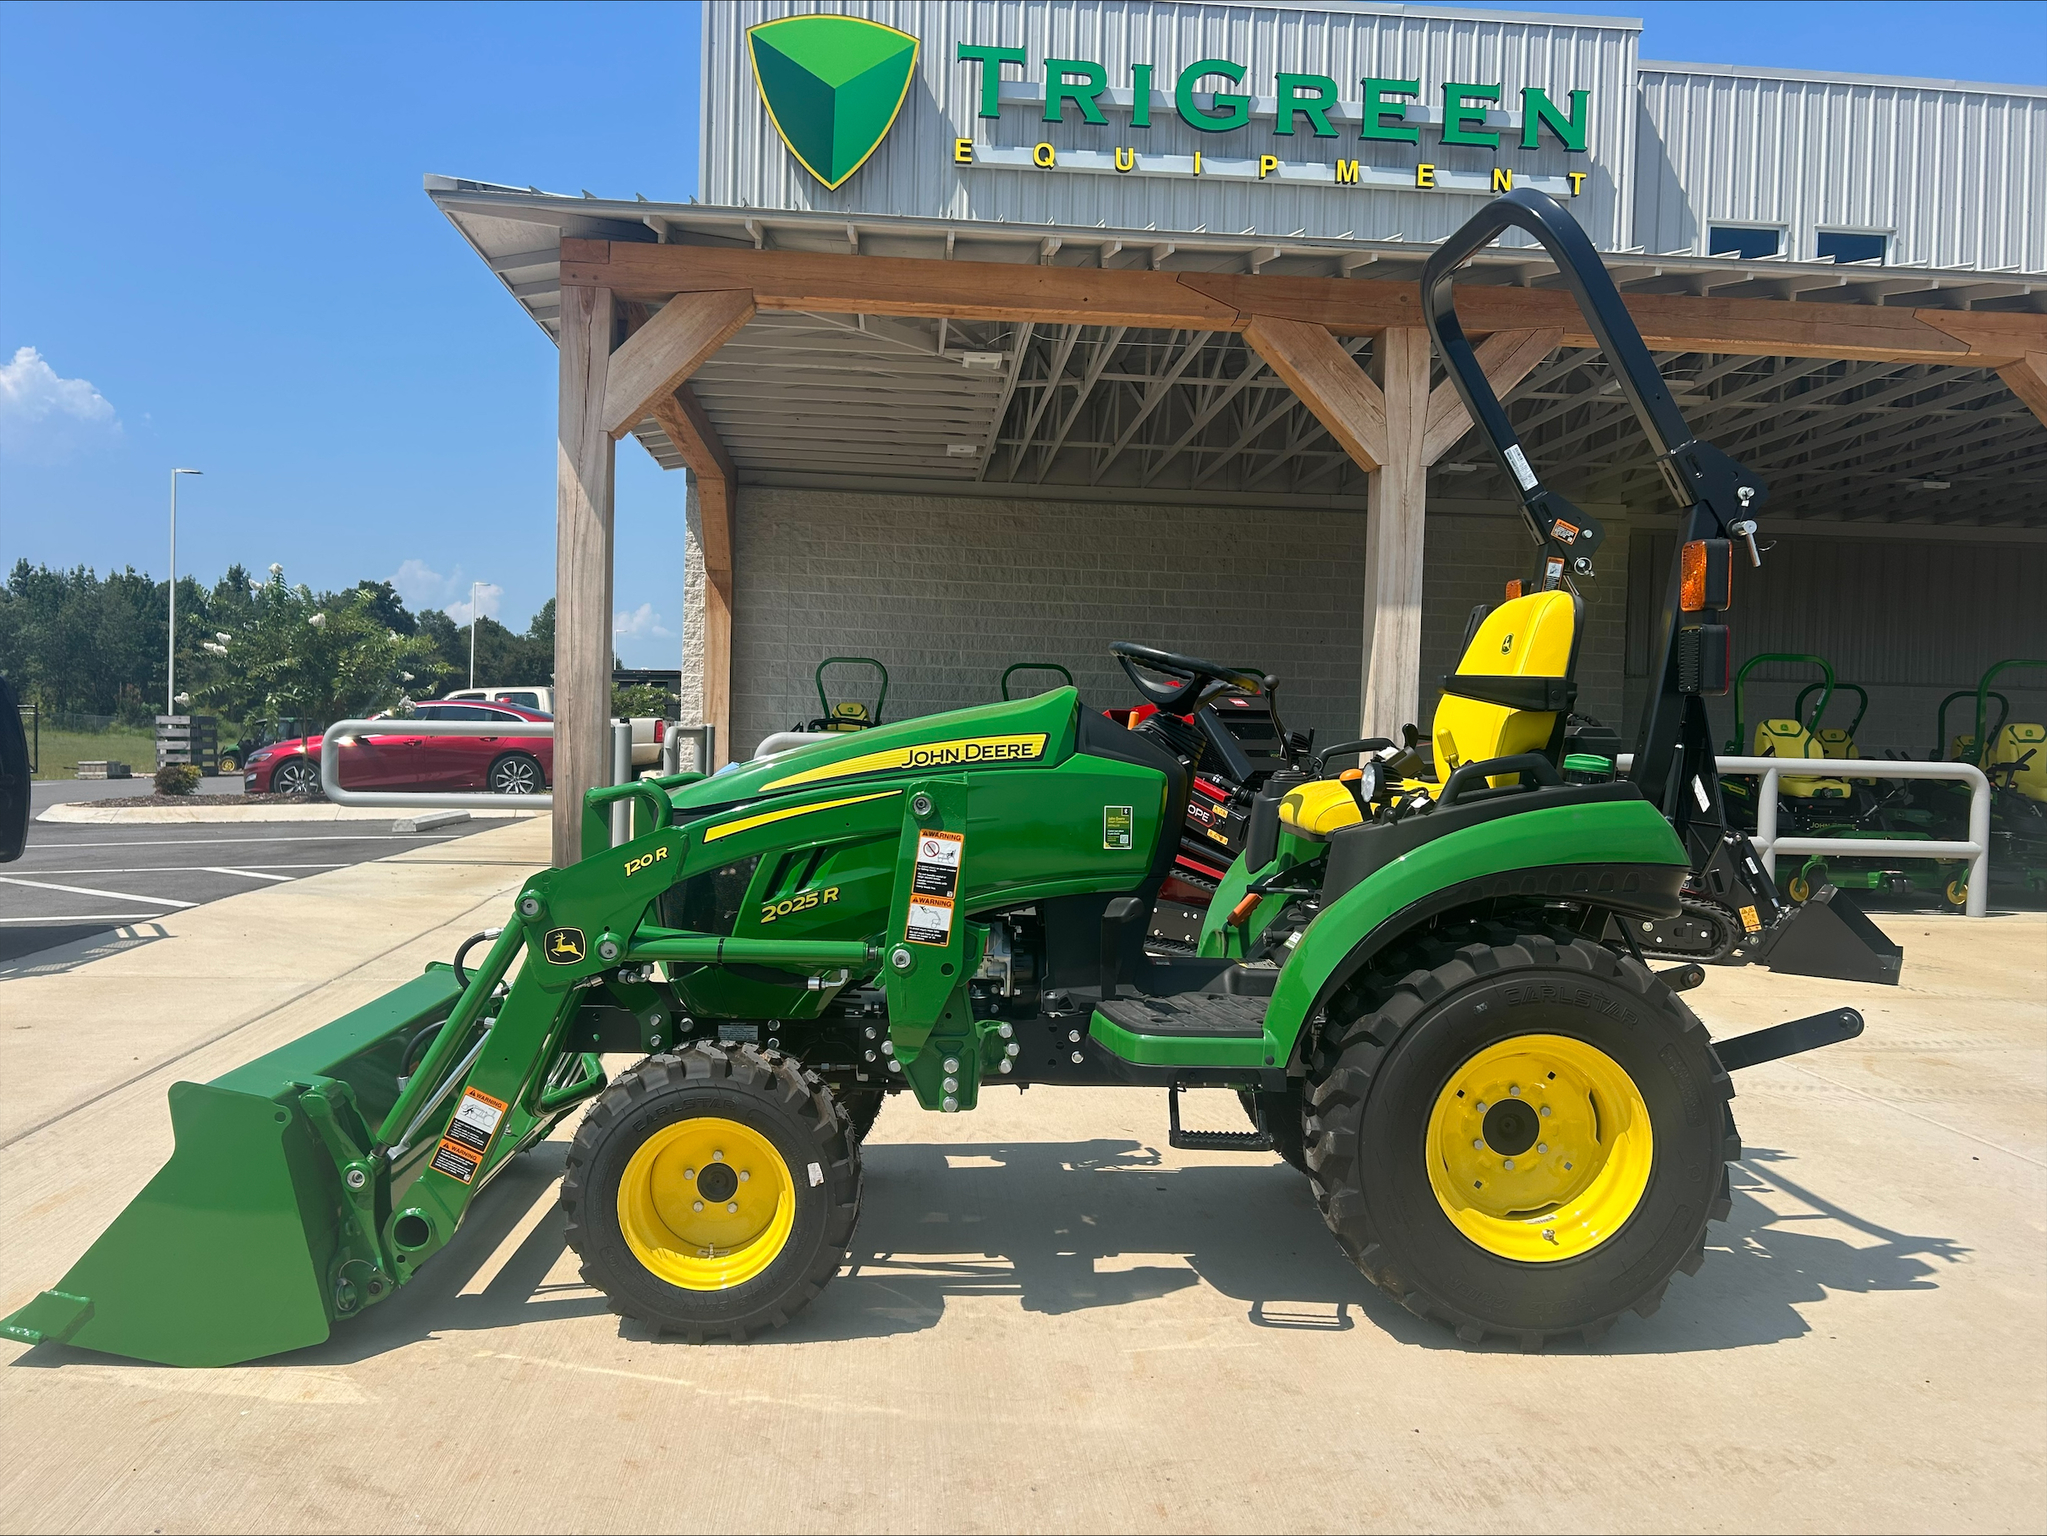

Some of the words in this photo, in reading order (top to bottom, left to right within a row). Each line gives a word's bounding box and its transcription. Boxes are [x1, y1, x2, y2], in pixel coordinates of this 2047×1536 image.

[957, 41, 1590, 153] TRIGREEN
[954, 138, 1587, 196] EQUIPMENT
[902, 747, 959, 766] JOHN
[965, 743, 1033, 760] DEERE
[928, 831, 961, 841] WARNING
[624, 853, 654, 877] 120
[655, 846, 669, 862] R
[760, 892, 819, 924] 2025
[823, 886, 840, 904] R
[918, 896, 952, 907] WARNING
[1504, 985, 1639, 1030] CARLSTAR
[477, 1094, 502, 1108] WARNING
[452, 1146, 477, 1161] WARNING
